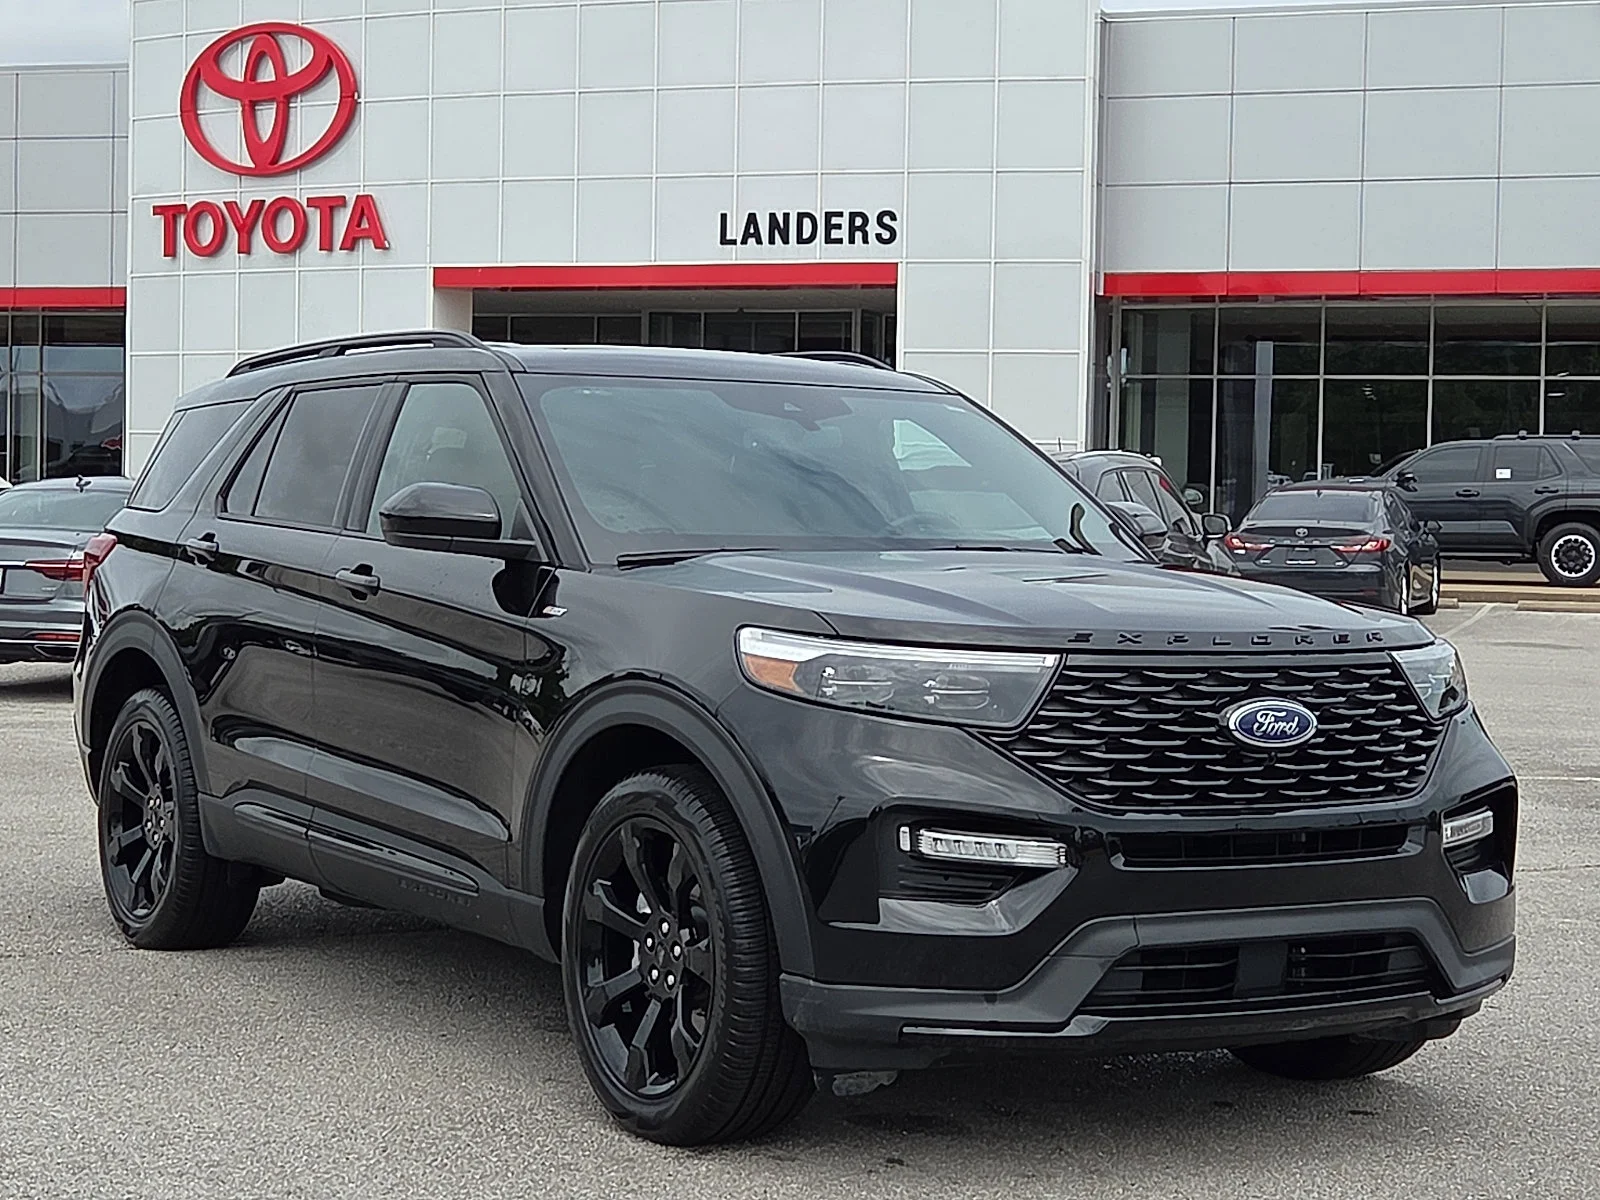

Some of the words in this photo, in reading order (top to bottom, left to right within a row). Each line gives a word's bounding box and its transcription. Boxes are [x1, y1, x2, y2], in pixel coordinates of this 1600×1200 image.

[152, 194, 390, 258] TOYOTA
[719, 210, 898, 246] LANDERS
[1067, 631, 1384, 646] EXPLORER
[1253, 710, 1300, 736] Ford
